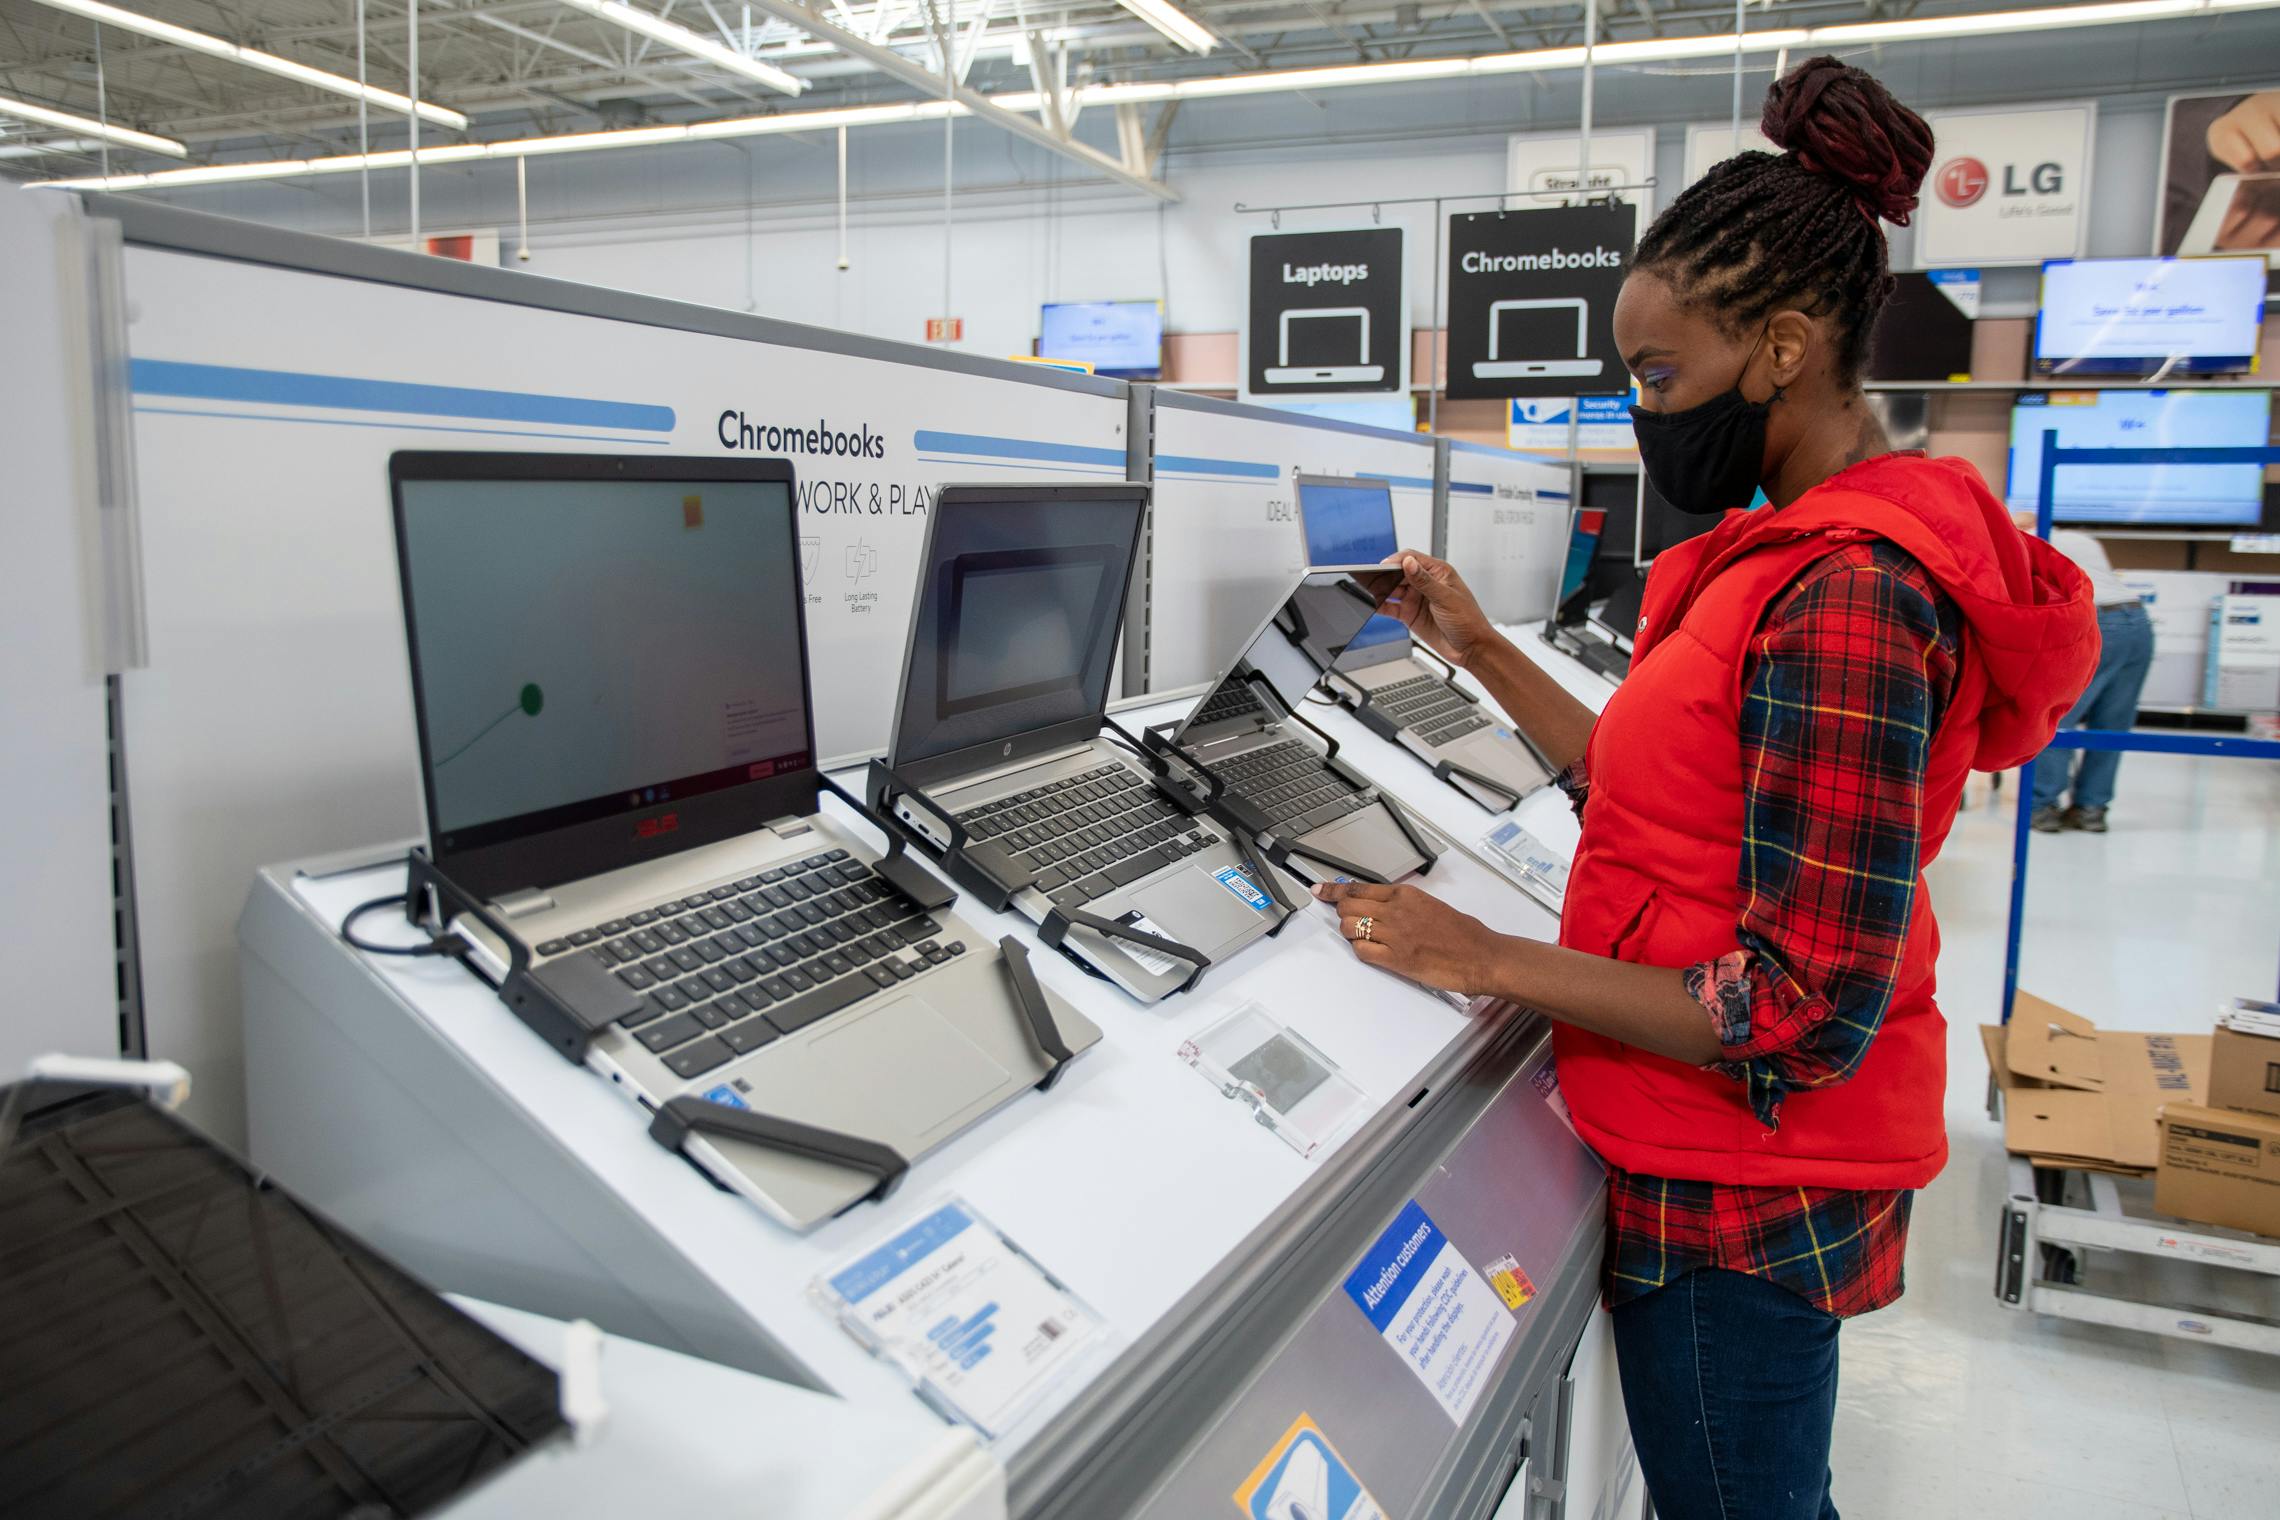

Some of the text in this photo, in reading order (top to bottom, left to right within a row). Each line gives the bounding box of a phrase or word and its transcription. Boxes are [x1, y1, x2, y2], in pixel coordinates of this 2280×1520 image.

[2003, 162, 2064, 197] LG
[1461, 245, 1621, 273] Chromebooks
[1283, 263, 1369, 287] Laptops
[931, 319, 957, 340] EXT
[1583, 399, 1620, 410] Security
[718, 409, 885, 459] Chromebooks
[798, 480, 862, 514] WORK
[869, 483, 883, 515] &
[1266, 500, 1292, 522] IDEAL
[808, 594, 822, 604] Free
[844, 591, 878, 604] Long Lasting
[851, 604, 872, 614] Battery
[1363, 1222, 1431, 1309] Attention customers
[1396, 1332, 1407, 1344] For
[1405, 1320, 1415, 1334] your
[1431, 1278, 1444, 1296] please
[1409, 1269, 1468, 1357] your hands following CDC guidelines
[1419, 1353, 1430, 1369] after
[1427, 1330, 1446, 1355] handling
[1441, 1321, 1451, 1333] the
